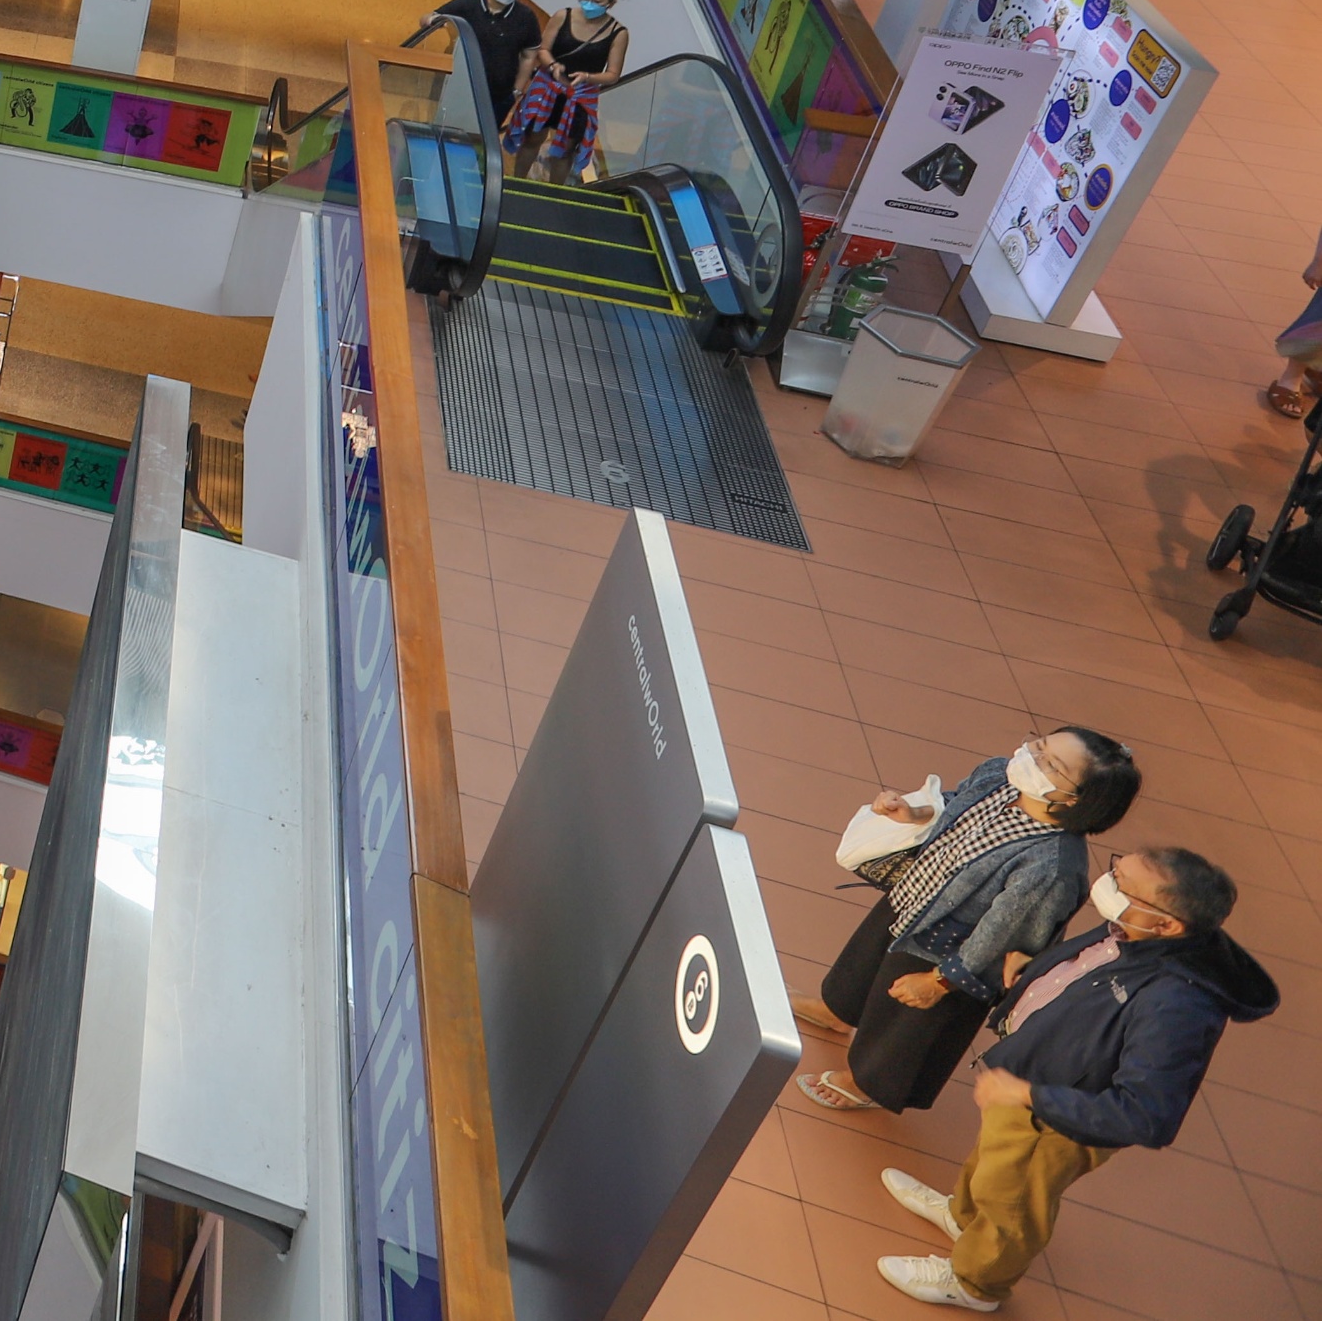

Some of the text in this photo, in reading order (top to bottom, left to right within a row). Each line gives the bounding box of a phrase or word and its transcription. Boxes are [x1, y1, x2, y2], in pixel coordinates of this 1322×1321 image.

[944, 59, 1024, 78] OPPO Find N2 Flip
[888, 201, 956, 217] OPPO BRAND SHOP
[733, 494, 786, 512] HITACHI
[627, 614, 668, 761] centralwOrld
